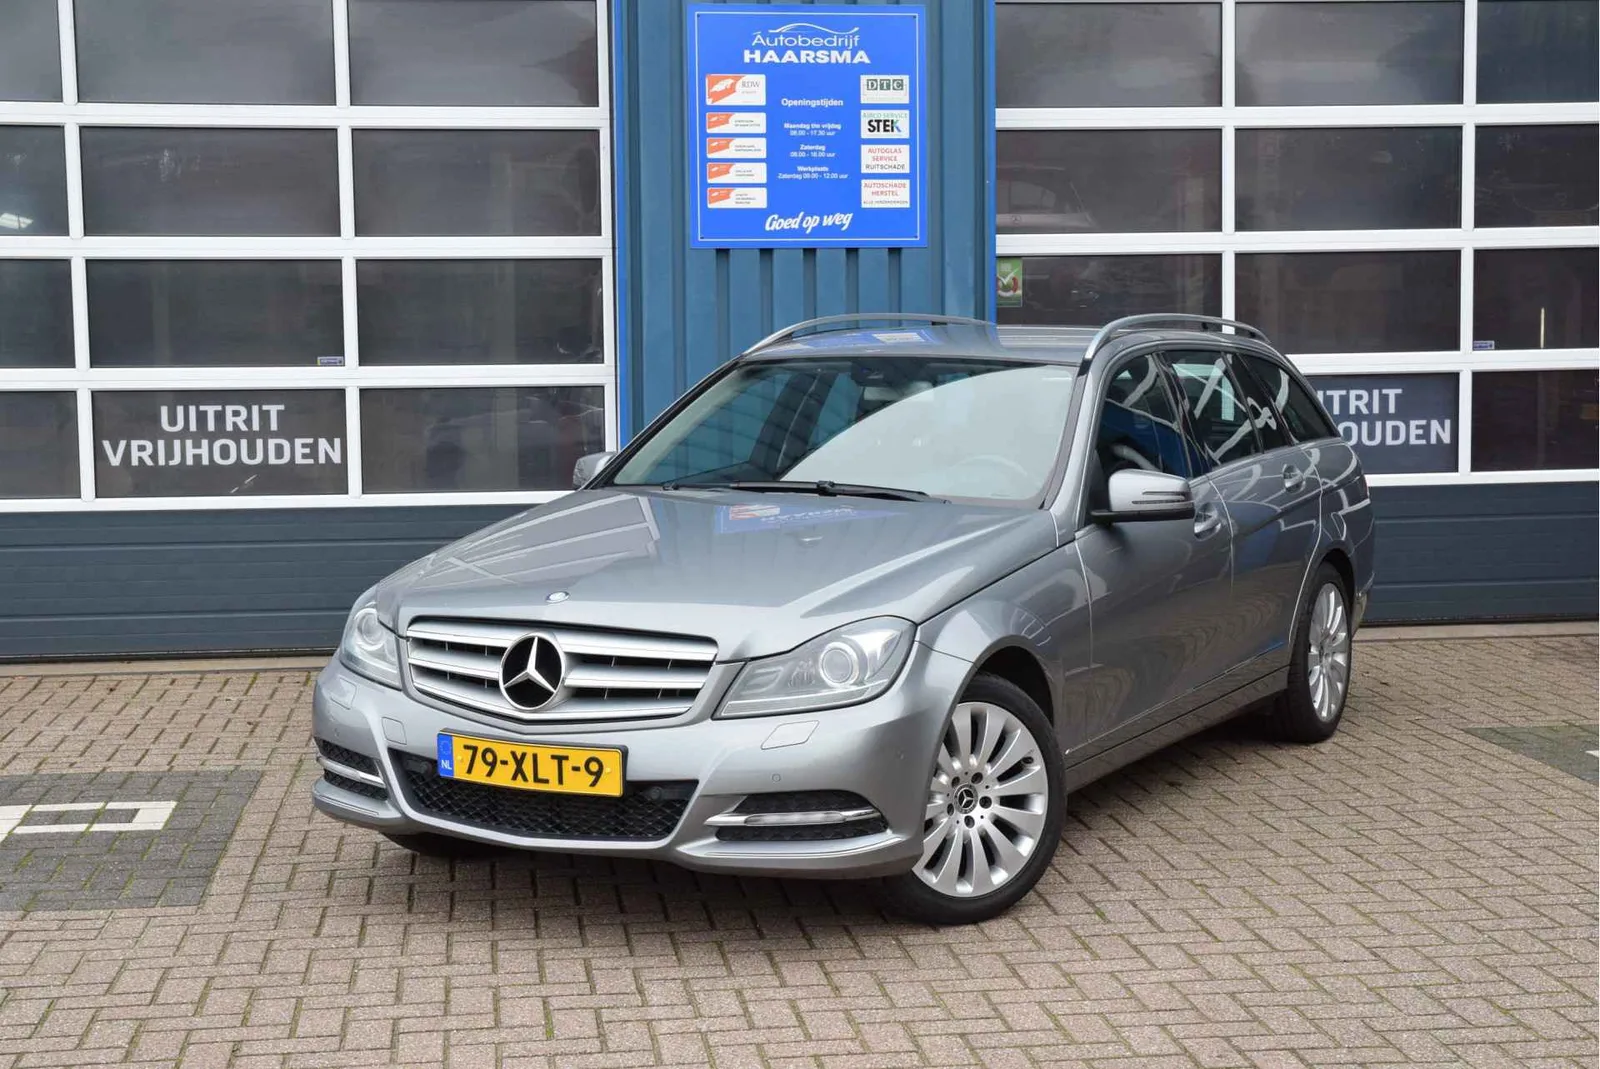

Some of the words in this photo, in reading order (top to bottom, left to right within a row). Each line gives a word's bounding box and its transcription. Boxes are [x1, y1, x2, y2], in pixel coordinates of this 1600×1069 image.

[752, 33, 860, 49] Autobedrijf
[743, 49, 871, 64] HAARSMA
[866, 79, 904, 90] DTC
[781, 98, 844, 108] Openingstijden
[867, 119, 902, 133] STEK
[765, 211, 804, 231] Goed
[802, 215, 820, 234] op
[822, 212, 854, 231] weg
[160, 404, 285, 432] UITRIT
[102, 437, 342, 467] VRIJHOUDEN
[441, 759, 452, 770] NL
[463, 744, 604, 788] 79-XLT-9
